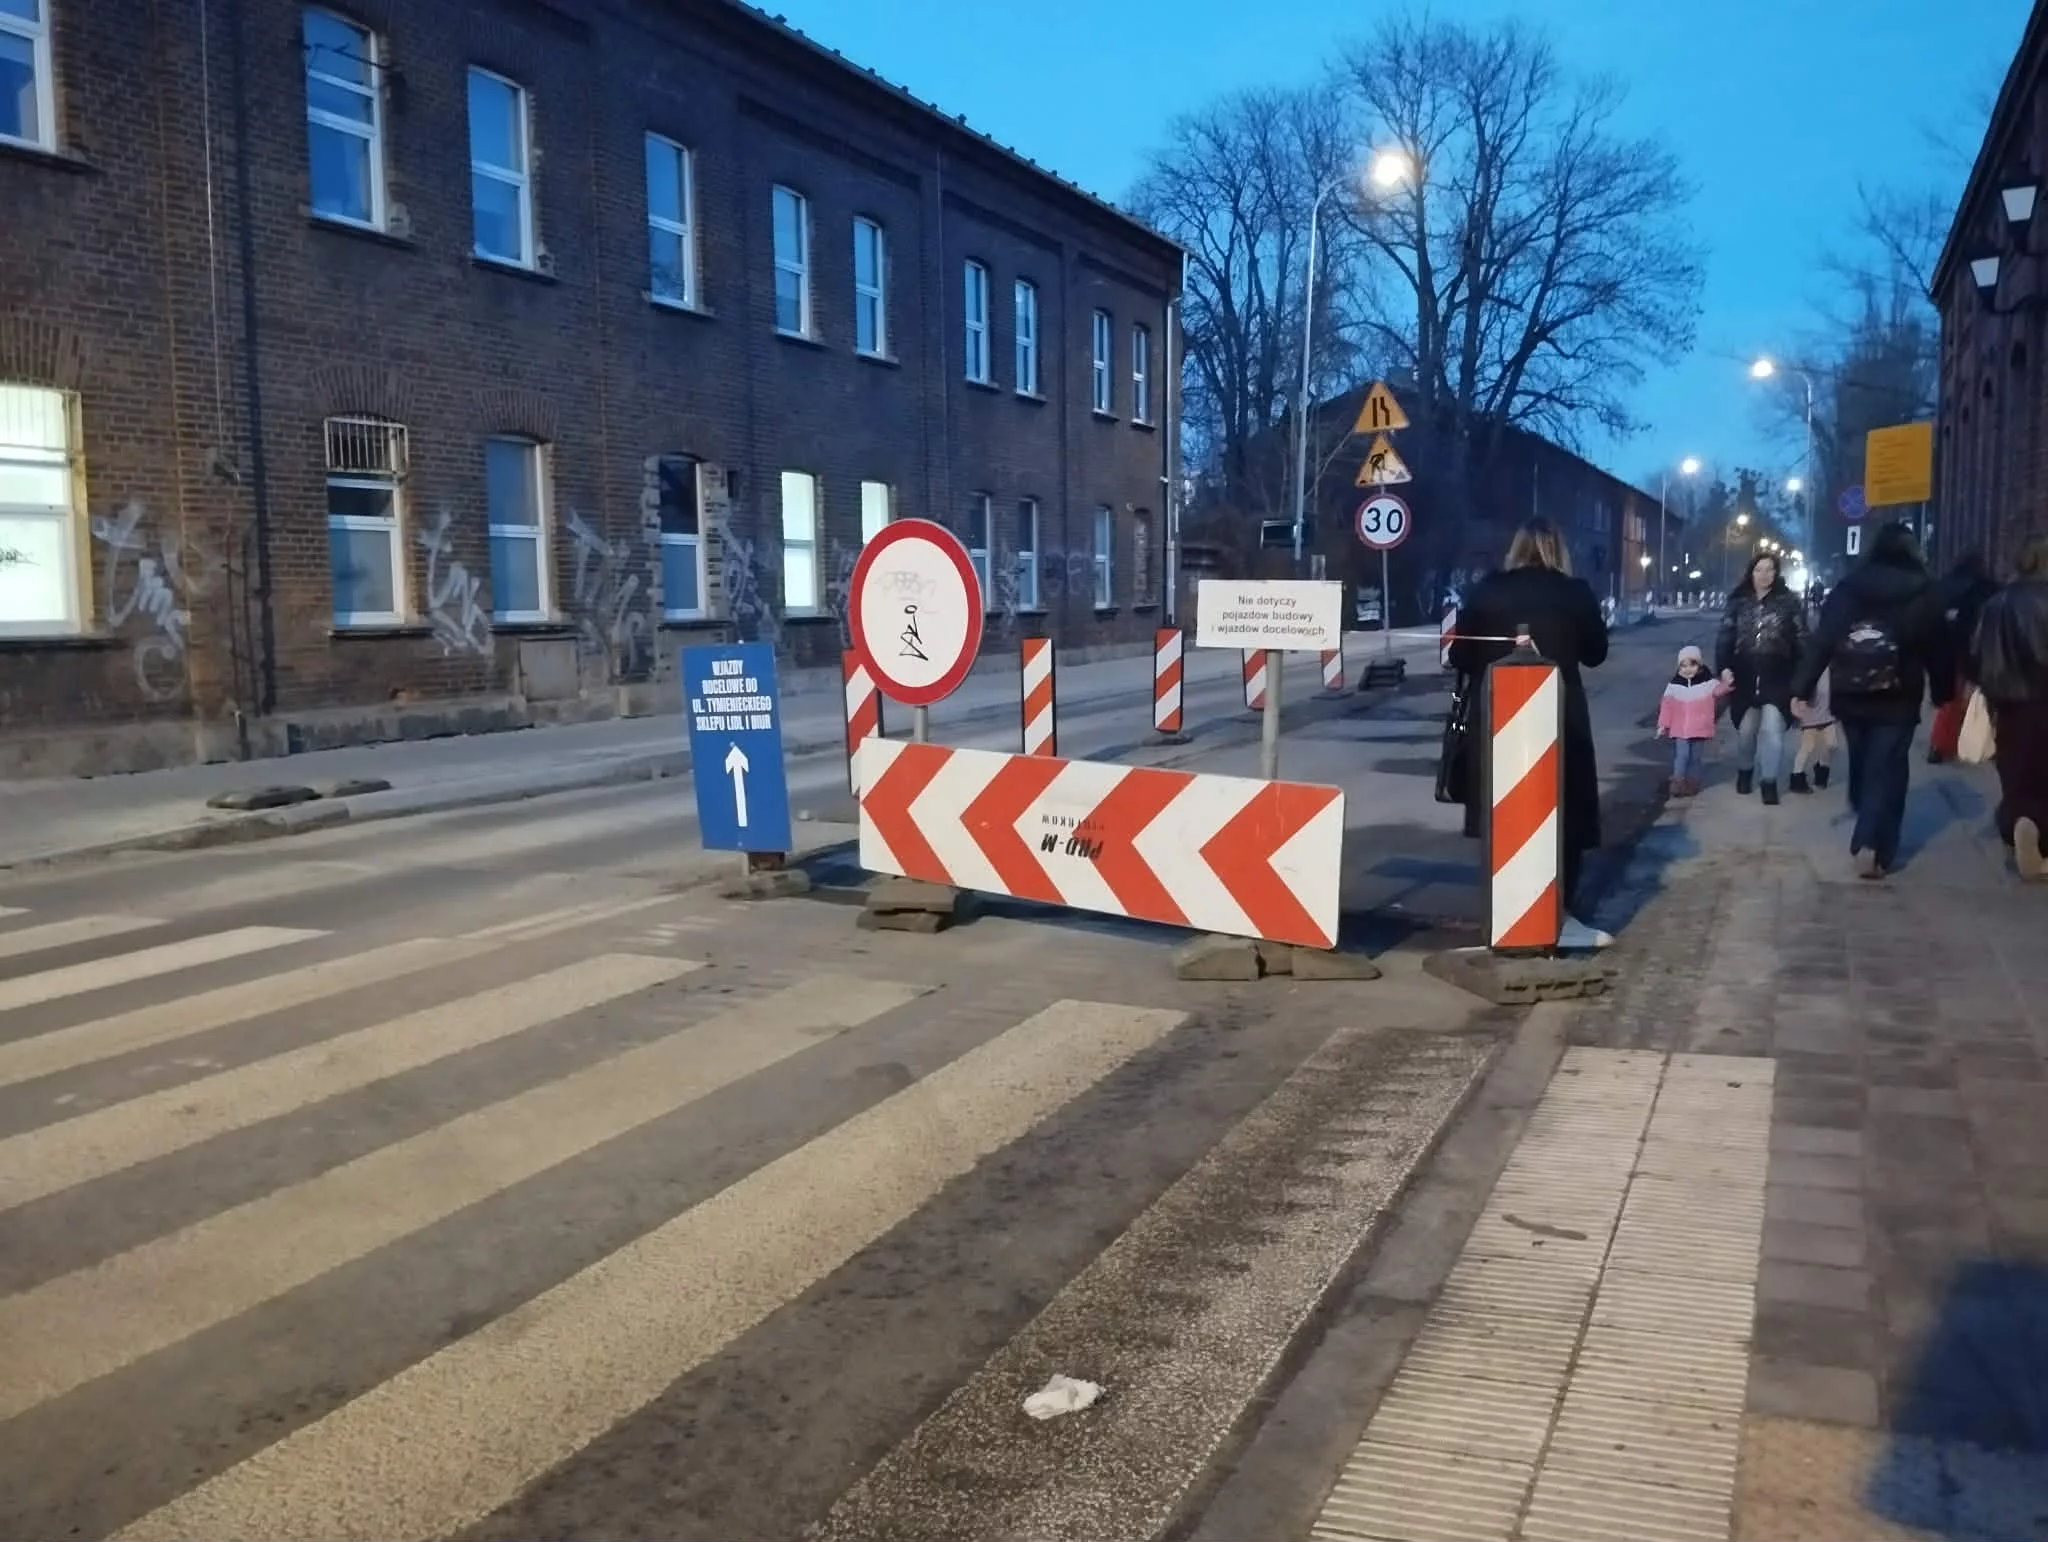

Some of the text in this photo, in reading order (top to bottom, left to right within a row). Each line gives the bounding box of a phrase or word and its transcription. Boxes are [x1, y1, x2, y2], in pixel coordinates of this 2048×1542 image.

[1365, 507, 1403, 533] 30
[1238, 595, 1297, 608] Nie dotyczy
[1272, 610, 1313, 623] budowy
[1262, 624, 1325, 636] docelowych
[712, 660, 743, 675] WJAZDY
[745, 677, 758, 692] DO
